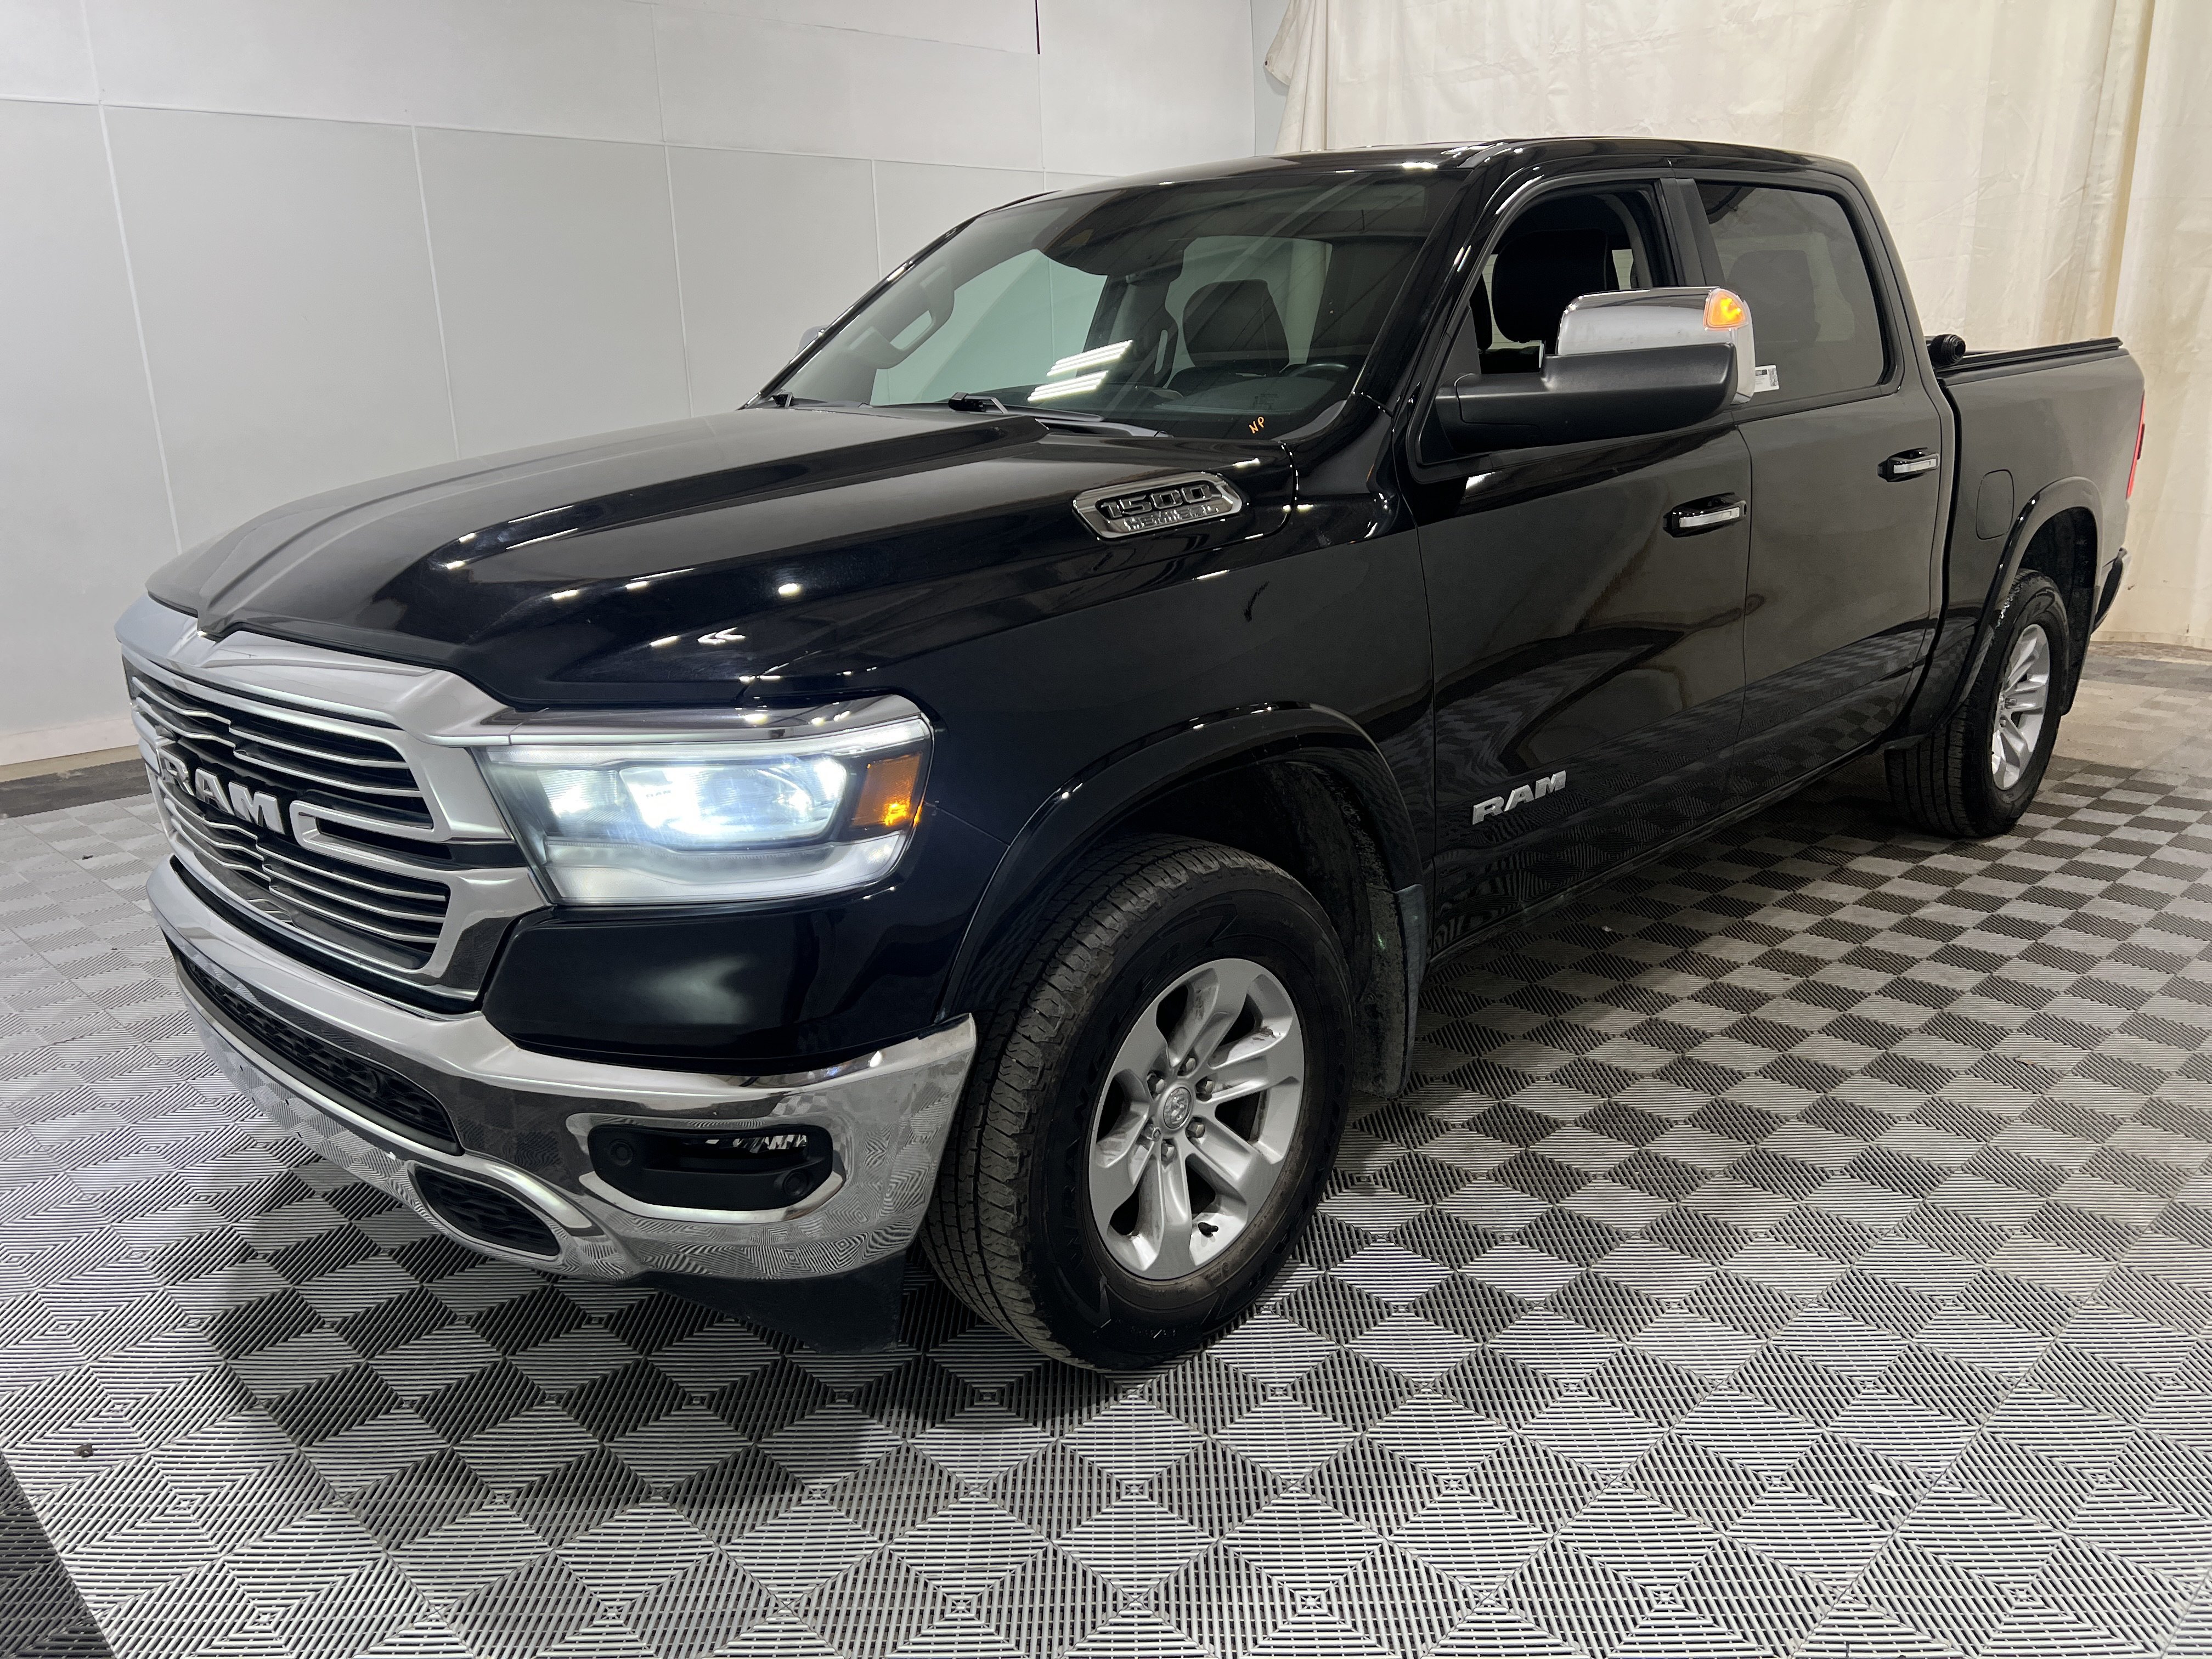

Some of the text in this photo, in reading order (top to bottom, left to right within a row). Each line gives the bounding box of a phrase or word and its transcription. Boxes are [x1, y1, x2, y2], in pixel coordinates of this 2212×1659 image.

[1249, 416, 1264, 433] NP
[1102, 484, 1212, 519] 1500
[1126, 508, 1181, 531] HEMI
[158, 747, 285, 834] RAM
[1472, 770, 1566, 825] RAM
